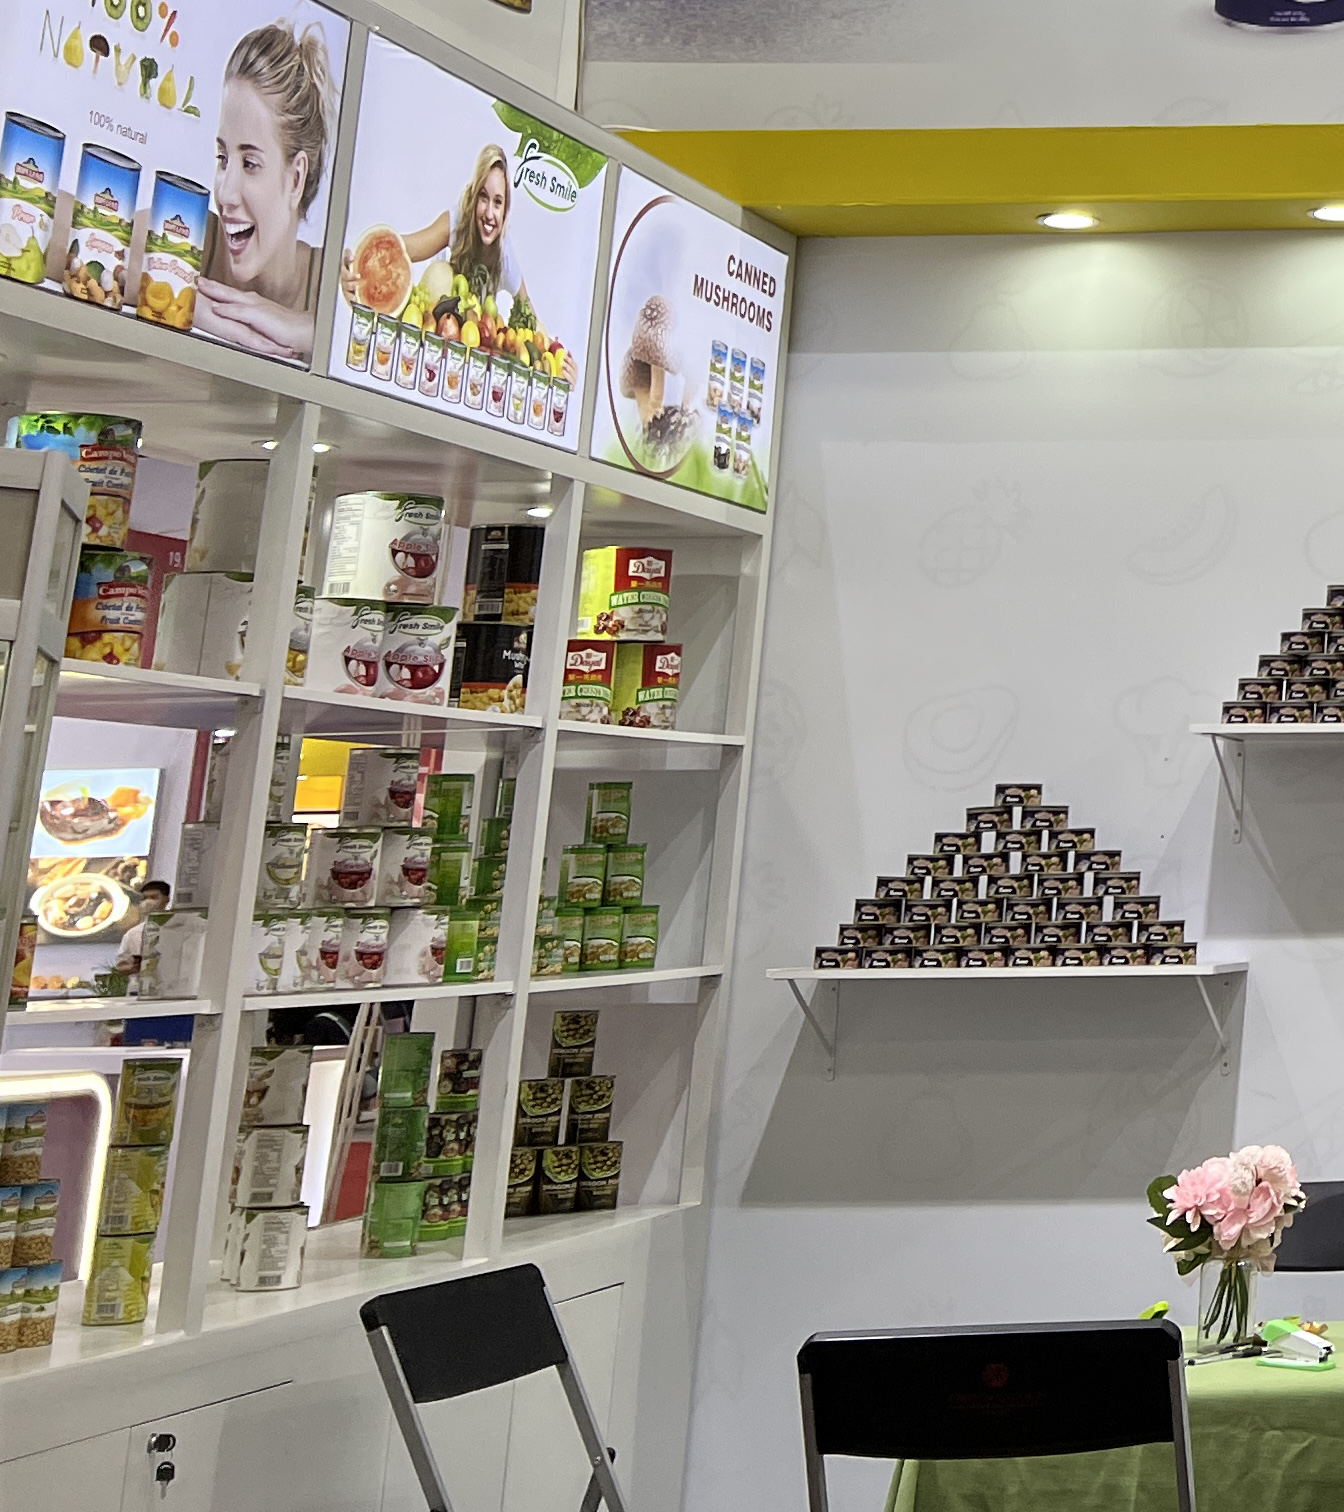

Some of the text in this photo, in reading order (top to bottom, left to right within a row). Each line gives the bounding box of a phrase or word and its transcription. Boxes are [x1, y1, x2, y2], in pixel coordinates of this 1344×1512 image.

[88, 109, 148, 145] 100% natural
[549, 176, 578, 204] Smile
[726, 253, 777, 299] CANNED
[692, 273, 774, 333] MUSHROOMS
